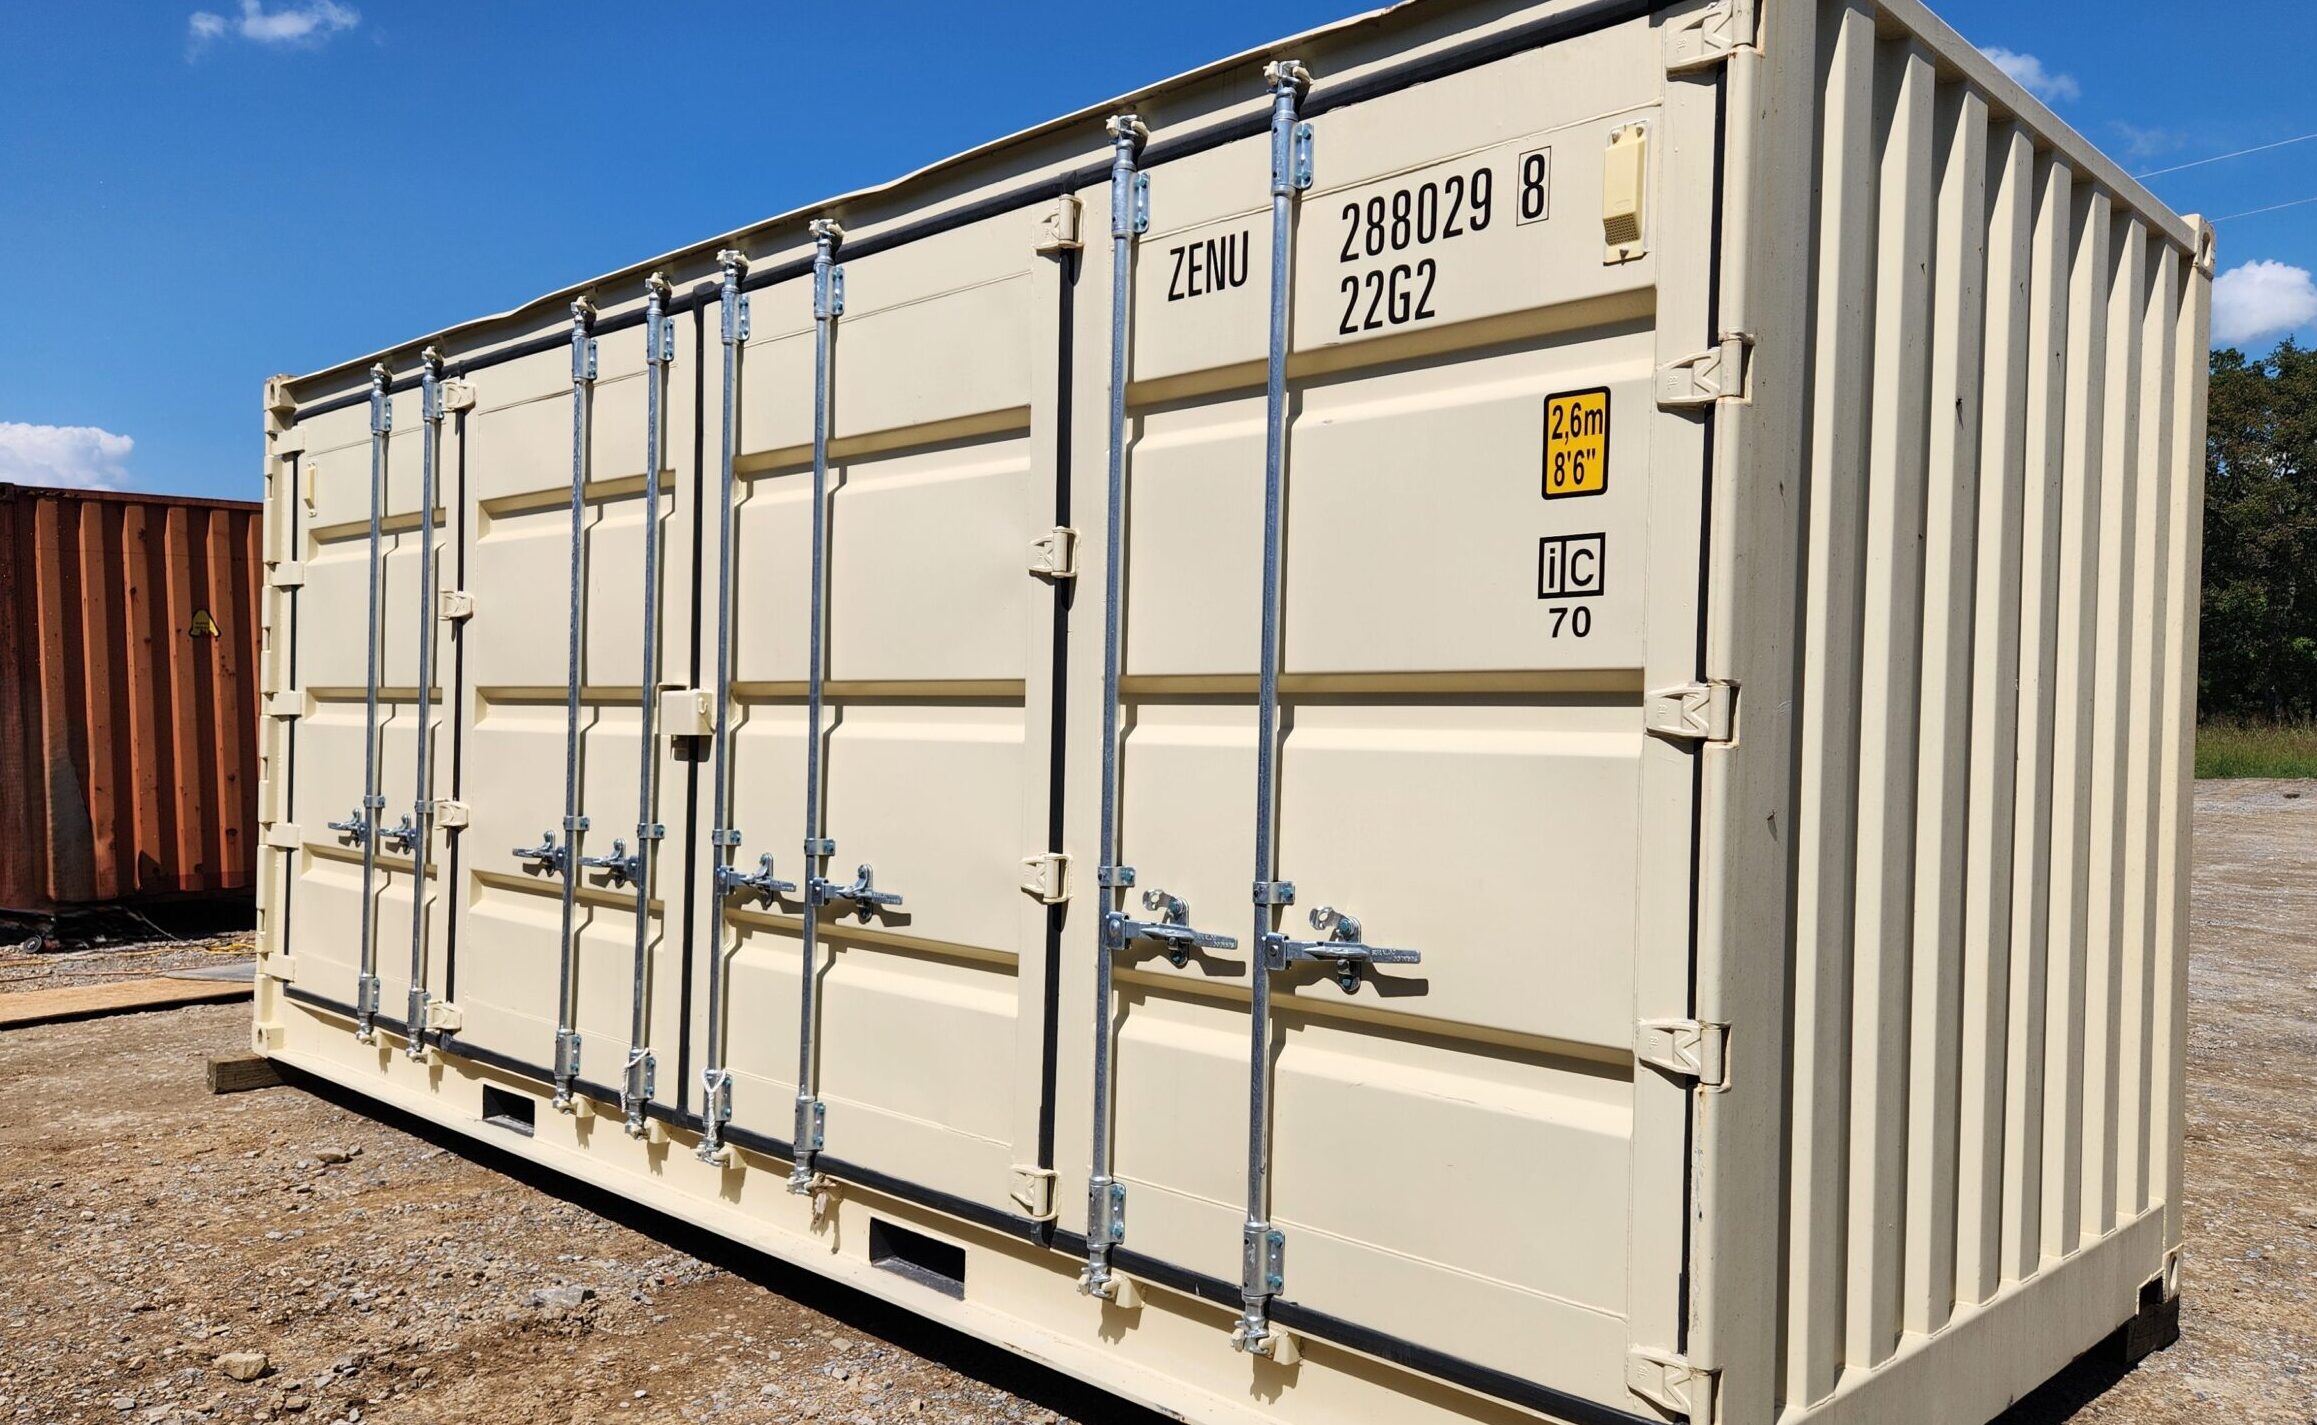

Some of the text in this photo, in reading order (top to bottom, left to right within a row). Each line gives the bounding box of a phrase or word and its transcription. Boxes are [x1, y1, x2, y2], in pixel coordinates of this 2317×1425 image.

[1167, 153, 1546, 302] ZENU 288029 8
[1340, 258, 1437, 335] 22G2
[1551, 402, 1604, 445] 2,6m
[1549, 605, 1592, 638] 70
